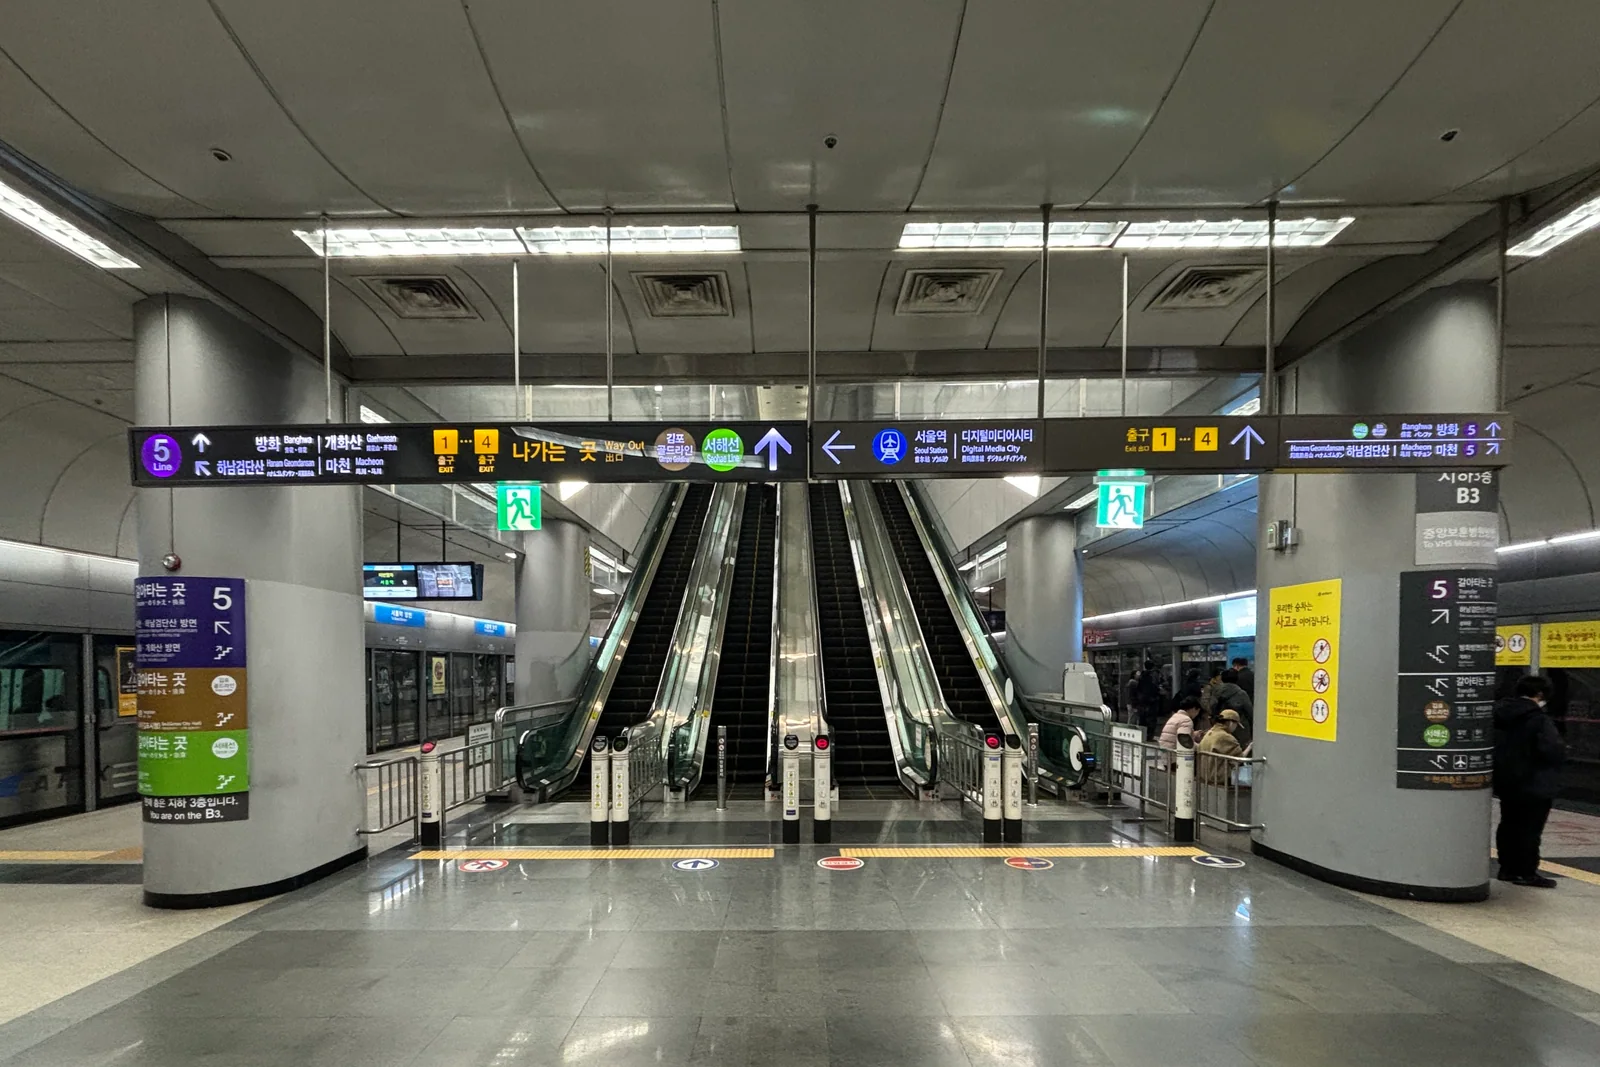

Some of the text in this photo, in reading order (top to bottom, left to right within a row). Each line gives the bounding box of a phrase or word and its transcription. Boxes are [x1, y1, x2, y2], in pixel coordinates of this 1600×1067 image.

[962, 429, 1033, 442] 디지털미디어시티
[1126, 428, 1150, 442] 출구
[1436, 424, 1459, 436] 방화
[1468, 424, 1476, 435] 5
[284, 436, 313, 446] Banghwa
[325, 434, 362, 450] 개화산
[442, 436, 448, 448] 1
[482, 436, 491, 448] 4
[666, 433, 684, 444] 김포
[914, 430, 946, 443] 서울역
[1160, 432, 1167, 446] 1
[1201, 432, 1211, 446] 4
[153, 439, 170, 459] 5
[255, 436, 280, 452] 방화
[604, 440, 644, 450] Way Out
[656, 444, 692, 456] 골드라인
[704, 438, 740, 452] 서해선
[914, 446, 948, 454] Seoul Station
[962, 445, 984, 454] Digital
[1006, 444, 1020, 454] City
[1436, 444, 1458, 456] 마천
[1466, 444, 1475, 456] 5
[512, 441, 597, 463] 나가는 곳
[1346, 444, 1390, 457] 하남검단산
[356, 458, 384, 466] Macheon
[438, 456, 454, 465] 출구
[478, 456, 496, 465] 출구
[605, 454, 624, 462] 出口
[728, 454, 740, 463] Line
[153, 463, 172, 472] Line
[216, 459, 264, 476] 하남검단산
[326, 458, 350, 474] 마천
[1456, 487, 1480, 504] B3
[172, 583, 186, 598] 곳
[1432, 580, 1447, 598] 5
[213, 586, 232, 610] 5
[180, 619, 198, 628] 방면
[1276, 616, 1332, 628] 사고로 이어집니다.
[165, 644, 180, 652] 방면
[172, 672, 186, 686] 곳
[174, 736, 188, 750] 곳
[168, 798, 186, 808] 지하
[190, 796, 238, 808] 3층입니다.
[160, 812, 172, 820] are
[174, 812, 185, 820] on
[188, 811, 202, 820] the
[206, 808, 224, 819] B3.
